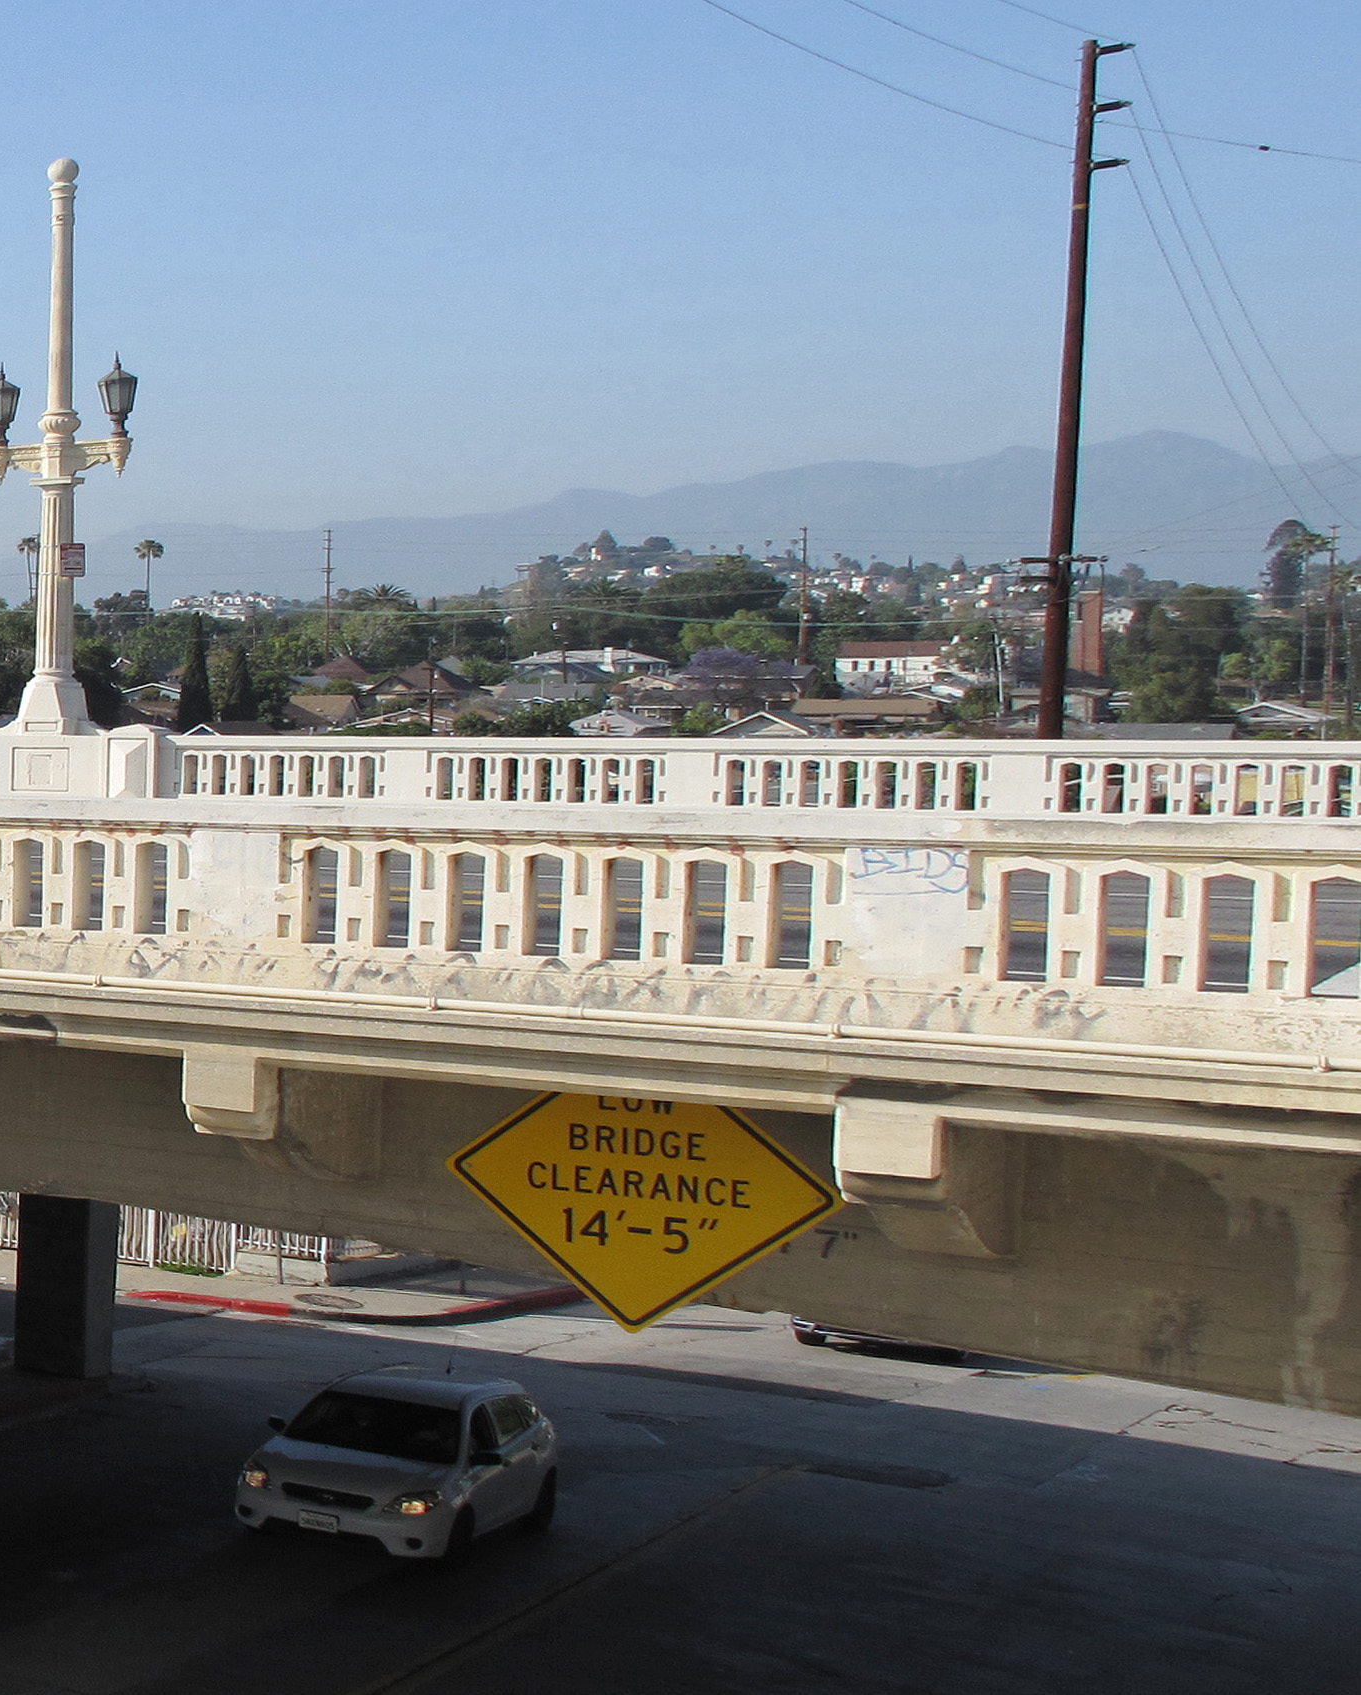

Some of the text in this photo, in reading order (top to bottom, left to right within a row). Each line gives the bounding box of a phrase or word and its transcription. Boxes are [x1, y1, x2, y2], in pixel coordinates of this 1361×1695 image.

[598, 1095, 673, 1115] LOW
[568, 1123, 707, 1161] BRIDGE
[527, 1161, 752, 1209] CLEARANCE
